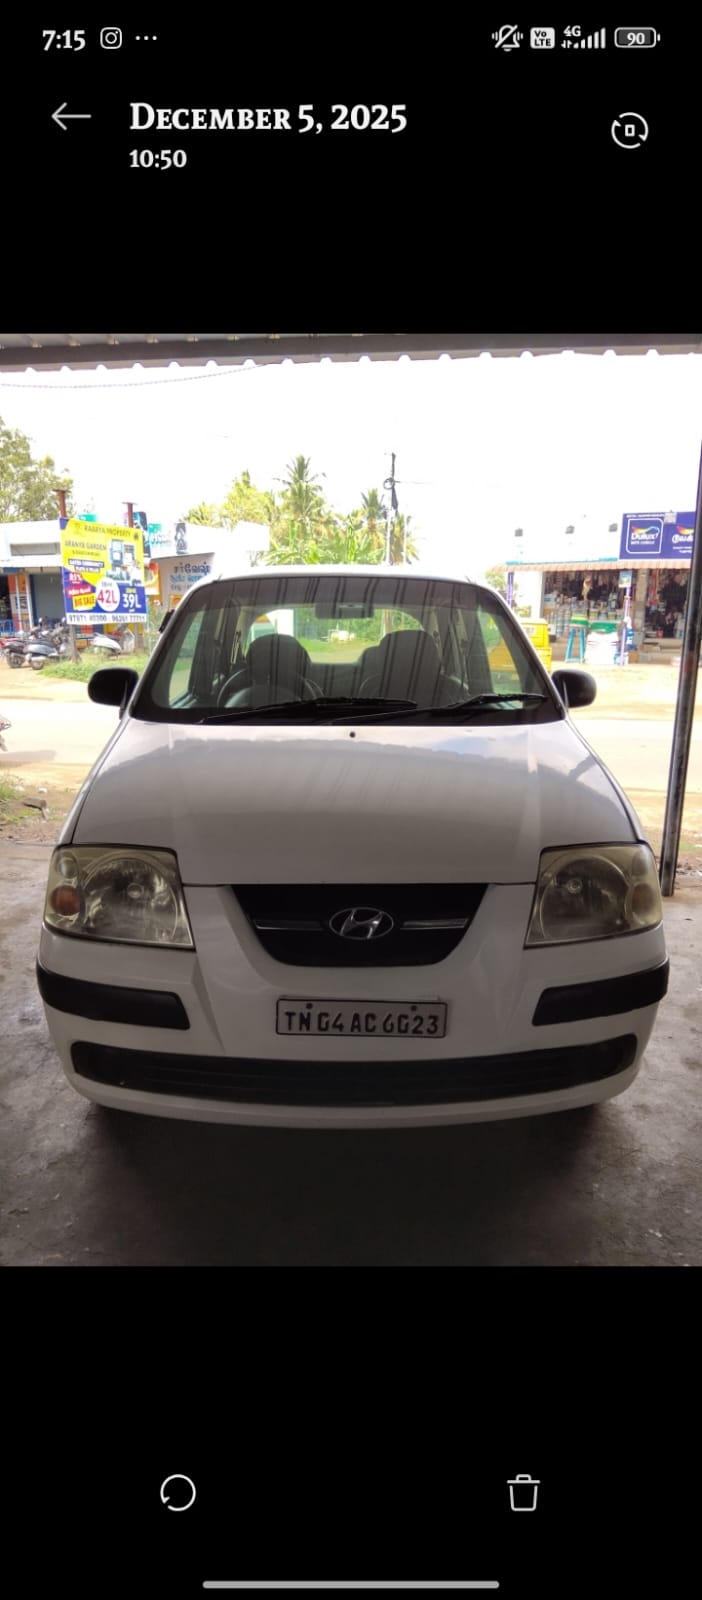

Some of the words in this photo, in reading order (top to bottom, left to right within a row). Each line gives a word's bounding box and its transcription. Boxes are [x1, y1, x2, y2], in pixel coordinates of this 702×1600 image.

[631, 532, 656, 540] Dulux
[86, 542, 107, 550] GARDEN
[97, 590, 118, 604] 42L
[123, 594, 142, 608] 39L
[284, 1011, 311, 1031] TN
[350, 1012, 377, 1033] AC
